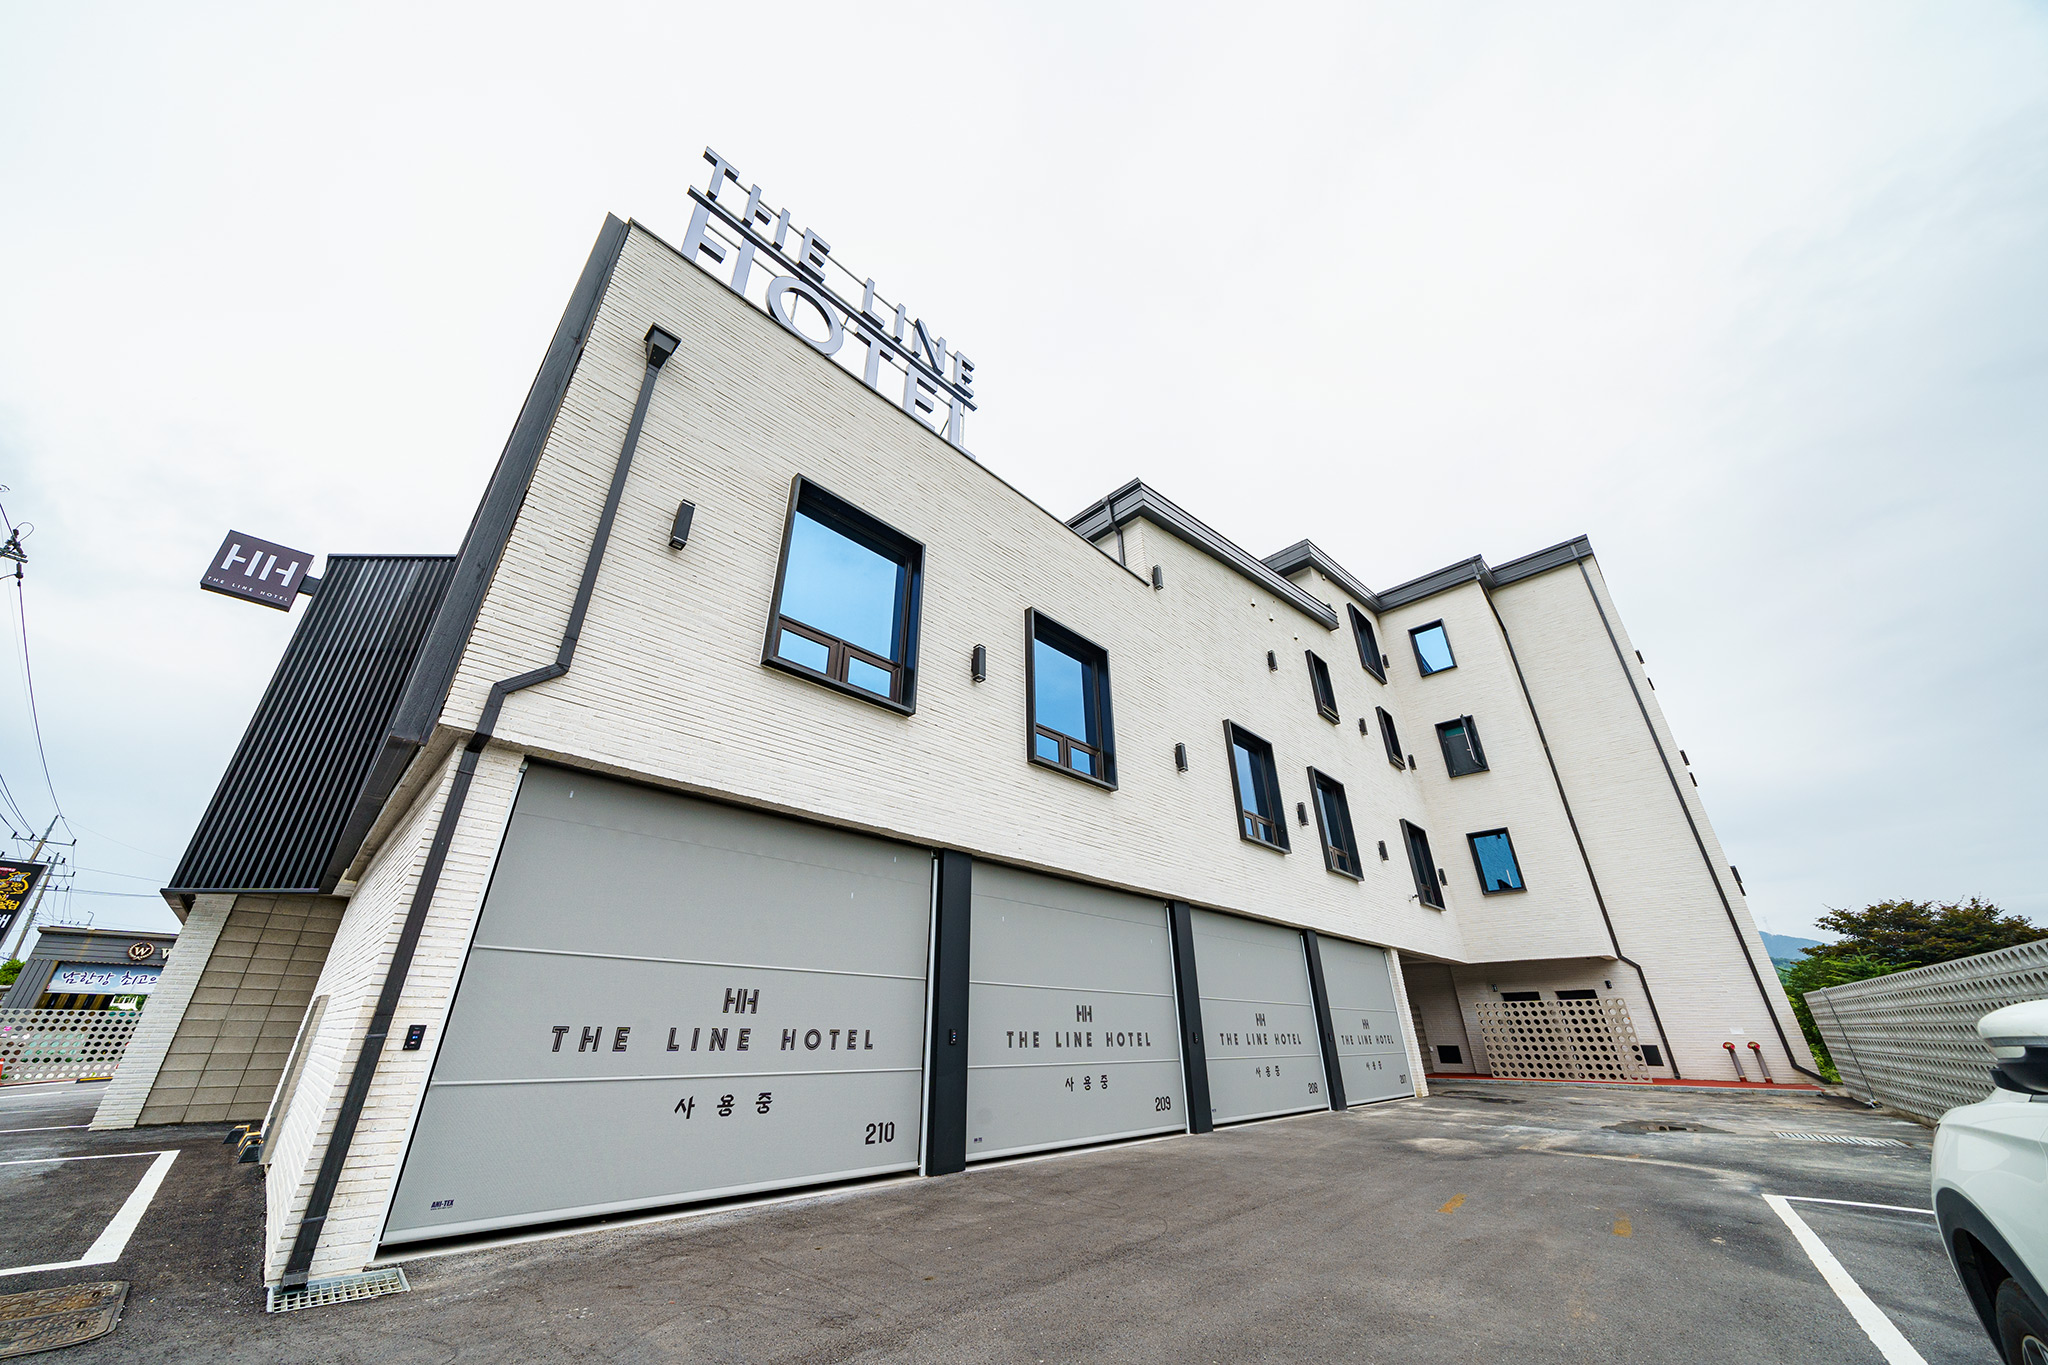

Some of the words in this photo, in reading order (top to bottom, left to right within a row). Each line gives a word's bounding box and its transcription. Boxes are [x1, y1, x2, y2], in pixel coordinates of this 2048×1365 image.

[703, 146, 831, 283] THE
[860, 277, 975, 398] LINE
[681, 201, 976, 460] HOTEL
[207, 576, 225, 585] THE
[231, 582, 254, 592] LINE
[260, 590, 289, 602] HOTEL
[62, 971, 115, 986] 남한강
[552, 1026, 631, 1052] THE
[666, 1027, 752, 1052] LINE
[780, 1028, 874, 1051] HOTEL
[1006, 1031, 1040, 1048] THE
[1055, 1031, 1093, 1048] LINE
[1105, 1032, 1151, 1047] HOTEL
[1219, 1033, 1239, 1045] THE
[1246, 1033, 1268, 1045] LINE
[1274, 1033, 1302, 1045] HOTEL
[1341, 1035, 1354, 1045] THE
[1357, 1035, 1373, 1045] LINE
[1375, 1035, 1394, 1044] HOTEL
[1308, 1082, 1319, 1094] 208
[1154, 1096, 1171, 1112] 209
[865, 1121, 895, 1145] 210
